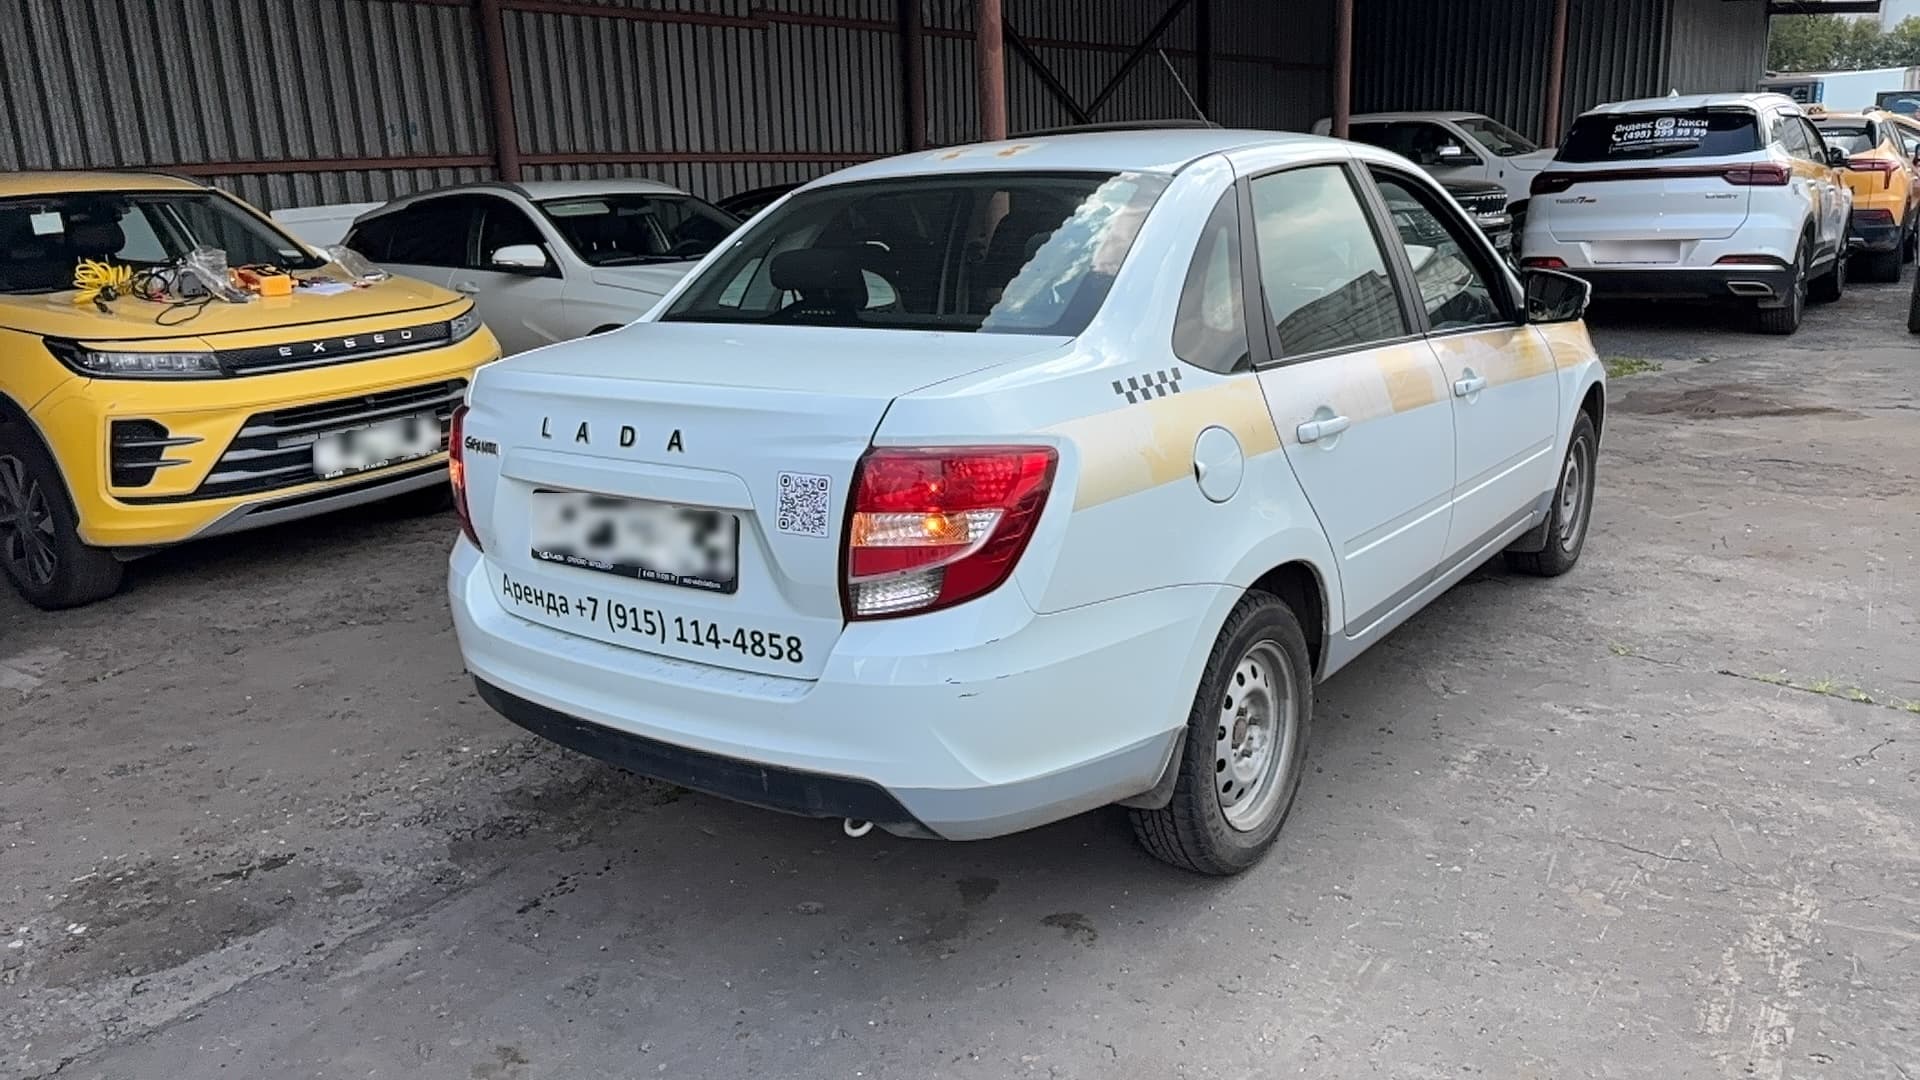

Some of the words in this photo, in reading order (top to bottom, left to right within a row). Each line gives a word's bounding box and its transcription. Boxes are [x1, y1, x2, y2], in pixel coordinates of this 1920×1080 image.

[1678, 118, 1709, 127] Такси
[279, 330, 412, 356] EXEED
[541, 416, 684, 453] LADA
[503, 573, 569, 617] Аренда
[576, 596, 598, 621] +7
[606, 599, 666, 644] (915)
[674, 616, 804, 663] 114-4858
